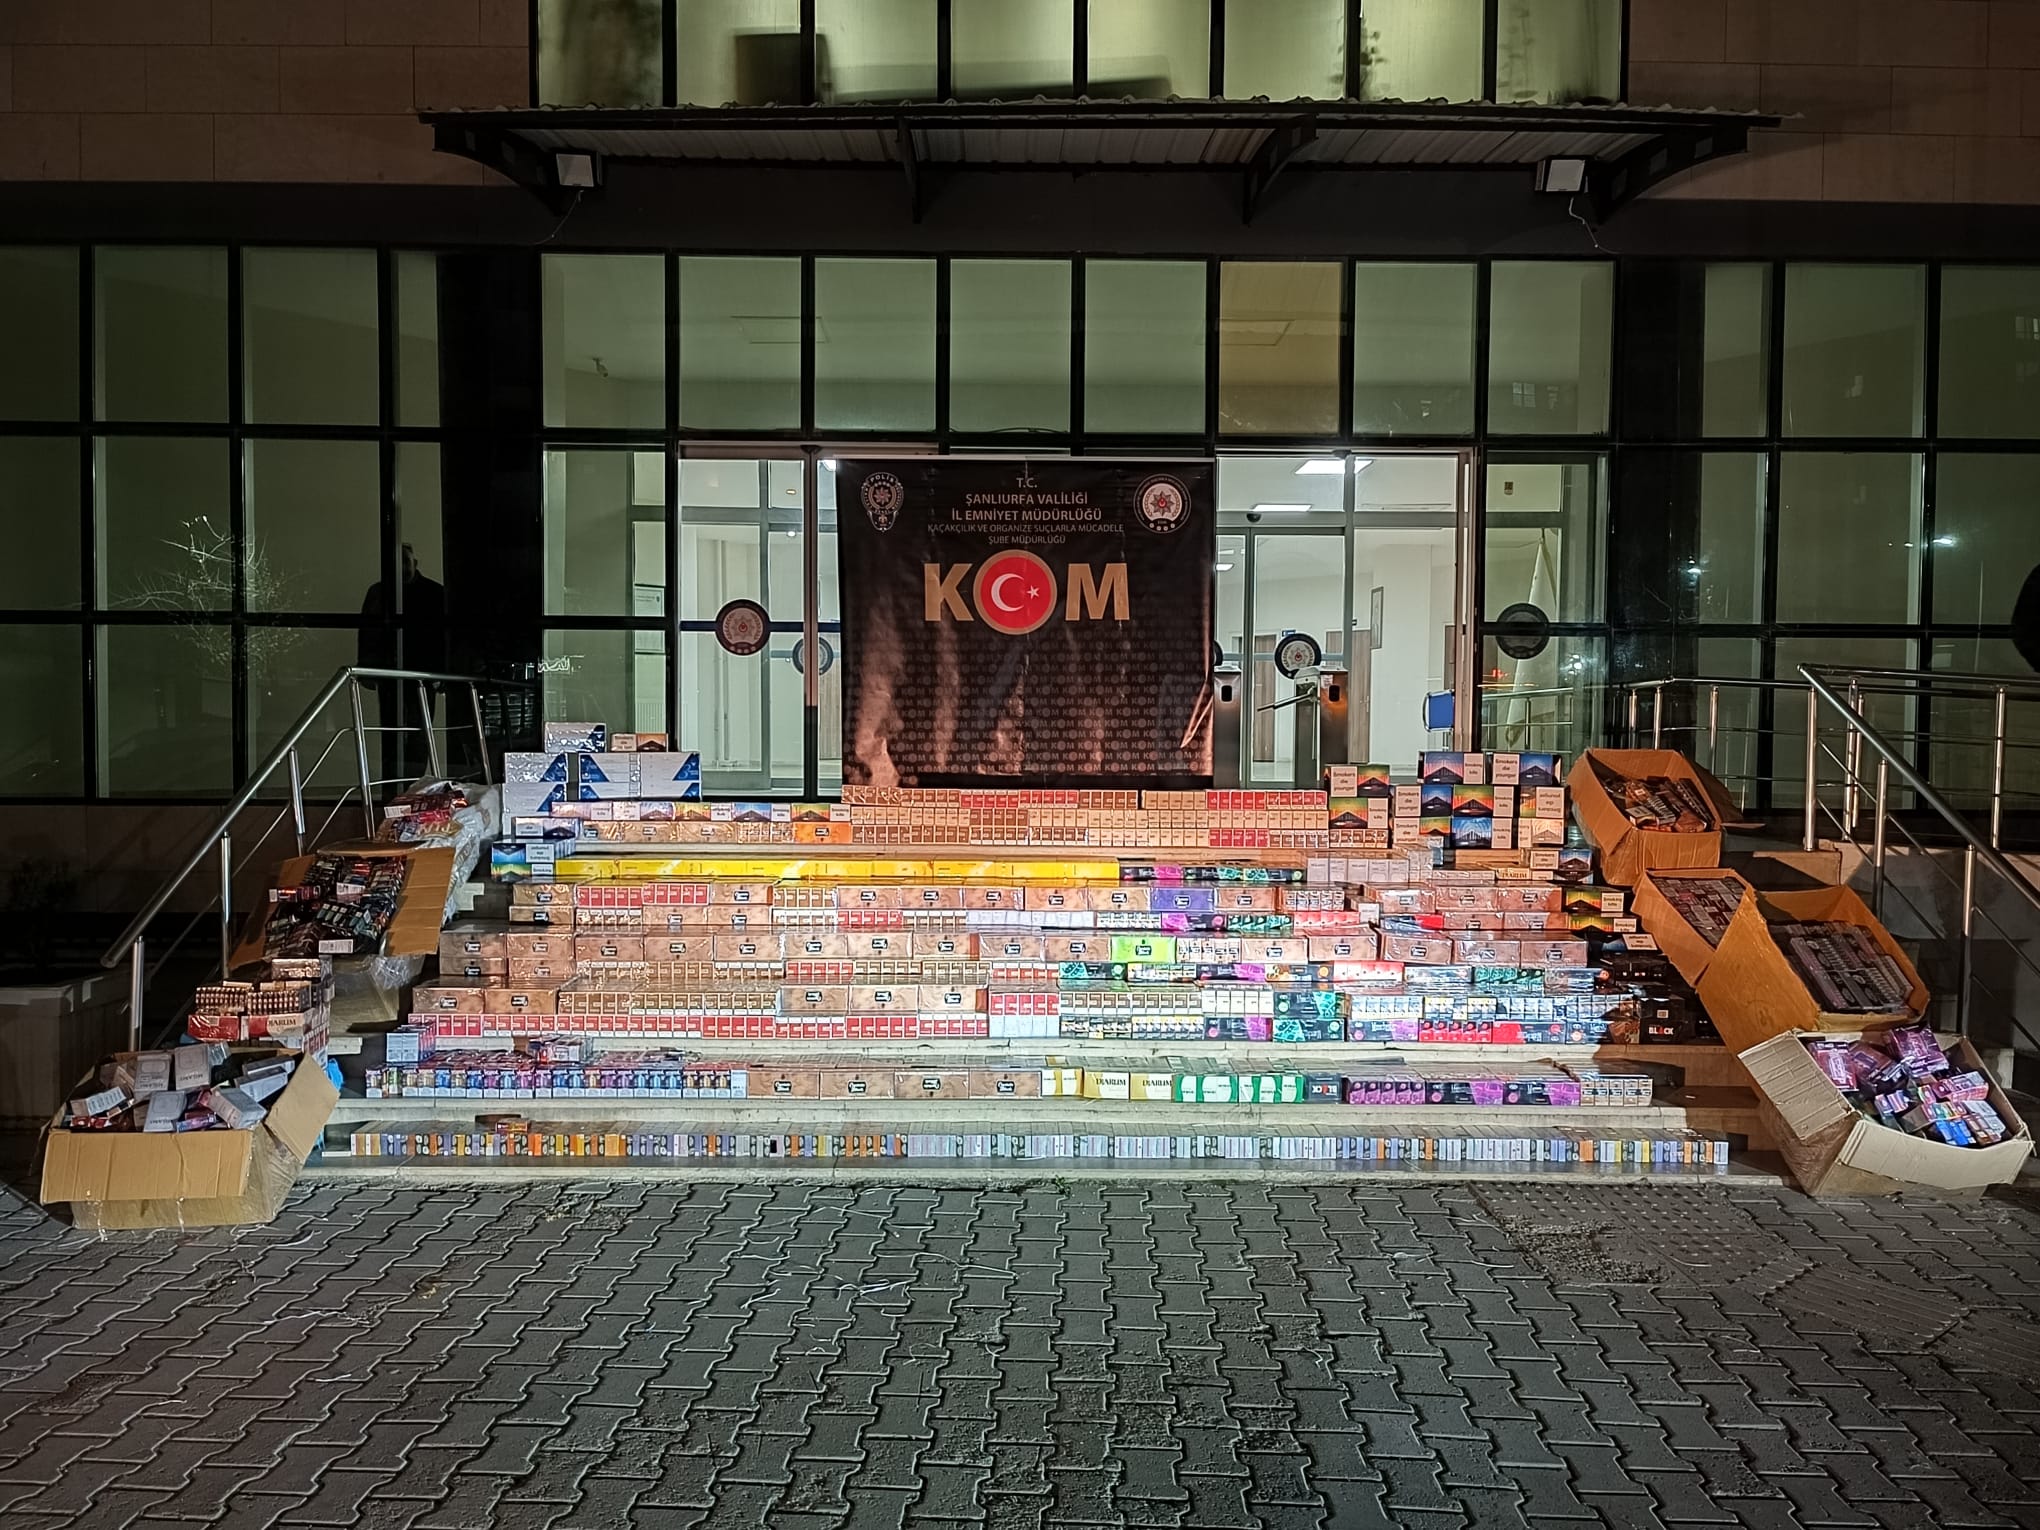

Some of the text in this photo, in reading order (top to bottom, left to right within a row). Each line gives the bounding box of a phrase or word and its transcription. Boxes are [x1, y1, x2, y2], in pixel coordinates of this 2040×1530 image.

[1016, 477, 1038, 488] T.C.
[965, 491, 1088, 507] ŞANLIURFA VALİLİĞİ
[952, 507, 1102, 521] İL EMNİYET MÜDÜRLÜĞÜ
[927, 521, 1125, 534] KAÇAKÇILIK VE ORGANİZE SUÇLARLA MÜCADELE
[988, 534, 1066, 545] ŞUBE MÜDÜRLÜĞÜ
[924, 549, 1130, 635] KOM
[1648, 1026, 1674, 1035] BLACK
